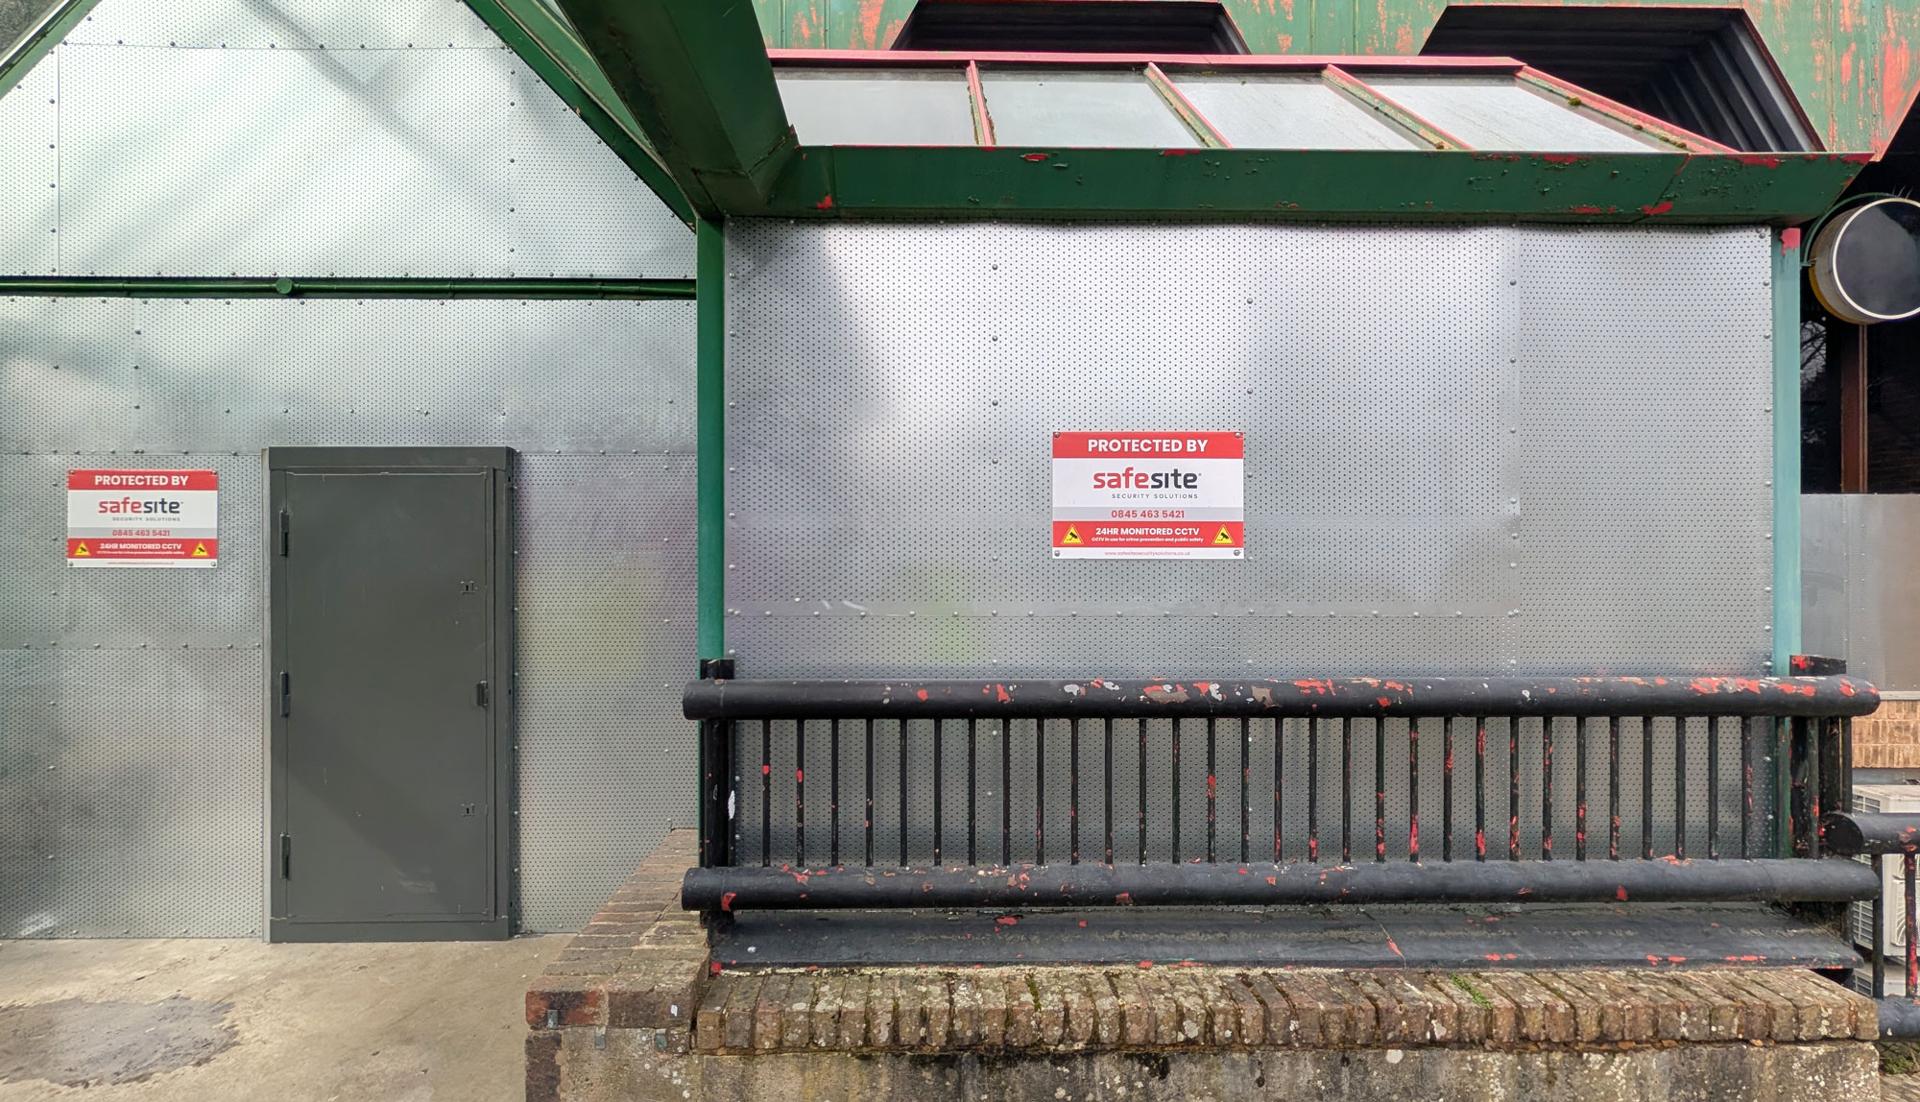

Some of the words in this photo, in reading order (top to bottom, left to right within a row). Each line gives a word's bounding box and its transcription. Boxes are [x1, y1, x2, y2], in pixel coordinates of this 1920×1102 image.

[1087, 439, 1183, 452] PROTECTED
[1186, 439, 1208, 452] BY
[94, 475, 168, 486] PROTECTED
[171, 475, 188, 486] BY
[1093, 467, 1198, 489] safesite
[98, 496, 180, 514] safesite
[1111, 510, 1138, 518] 0845
[1140, 510, 1160, 518] 463
[1162, 510, 1185, 518] 5421
[1095, 527, 1119, 536] 24HR
[1120, 527, 1173, 536] MONITORED
[1174, 527, 1200, 536] CCTV
